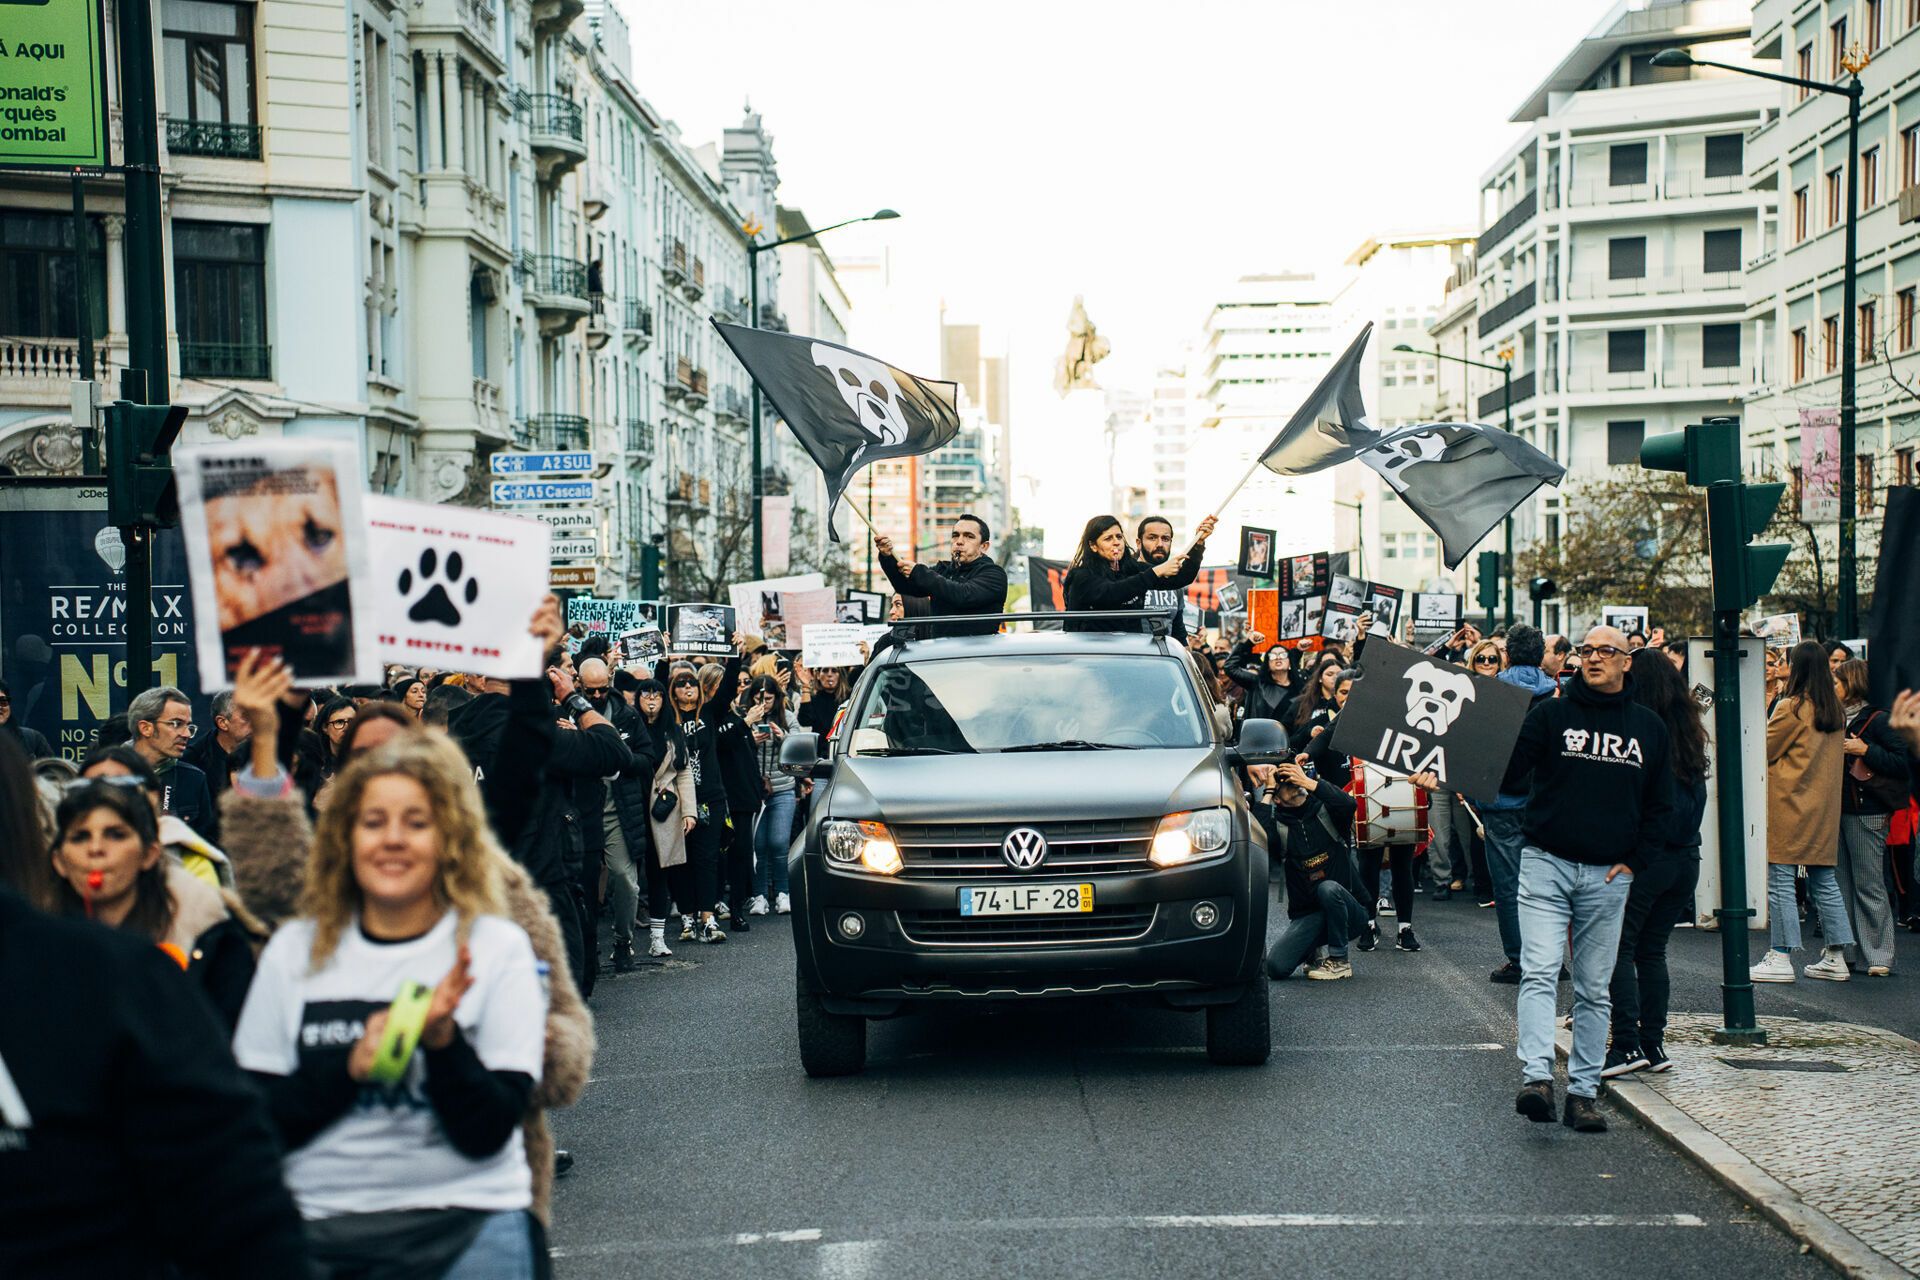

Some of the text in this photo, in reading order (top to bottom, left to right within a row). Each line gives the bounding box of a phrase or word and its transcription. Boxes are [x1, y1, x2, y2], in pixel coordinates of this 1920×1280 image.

[15, 42, 65, 61] AQUI
[0, 127, 66, 142] ombal
[563, 455, 592, 469] SUL
[545, 484, 592, 498] Cascais
[107, 583, 127, 591] THE
[1154, 589, 1178, 606] IRA
[582, 601, 598, 611] QUE
[569, 610, 634, 622] DEFENDE QUEM
[52, 622, 184, 636] COLLECON
[609, 621, 629, 632] PODE
[61, 729, 86, 742] NO
[1592, 731, 1643, 763] IRA
[1376, 728, 1447, 783] IRA
[1083, 900, 1091, 908] 01
